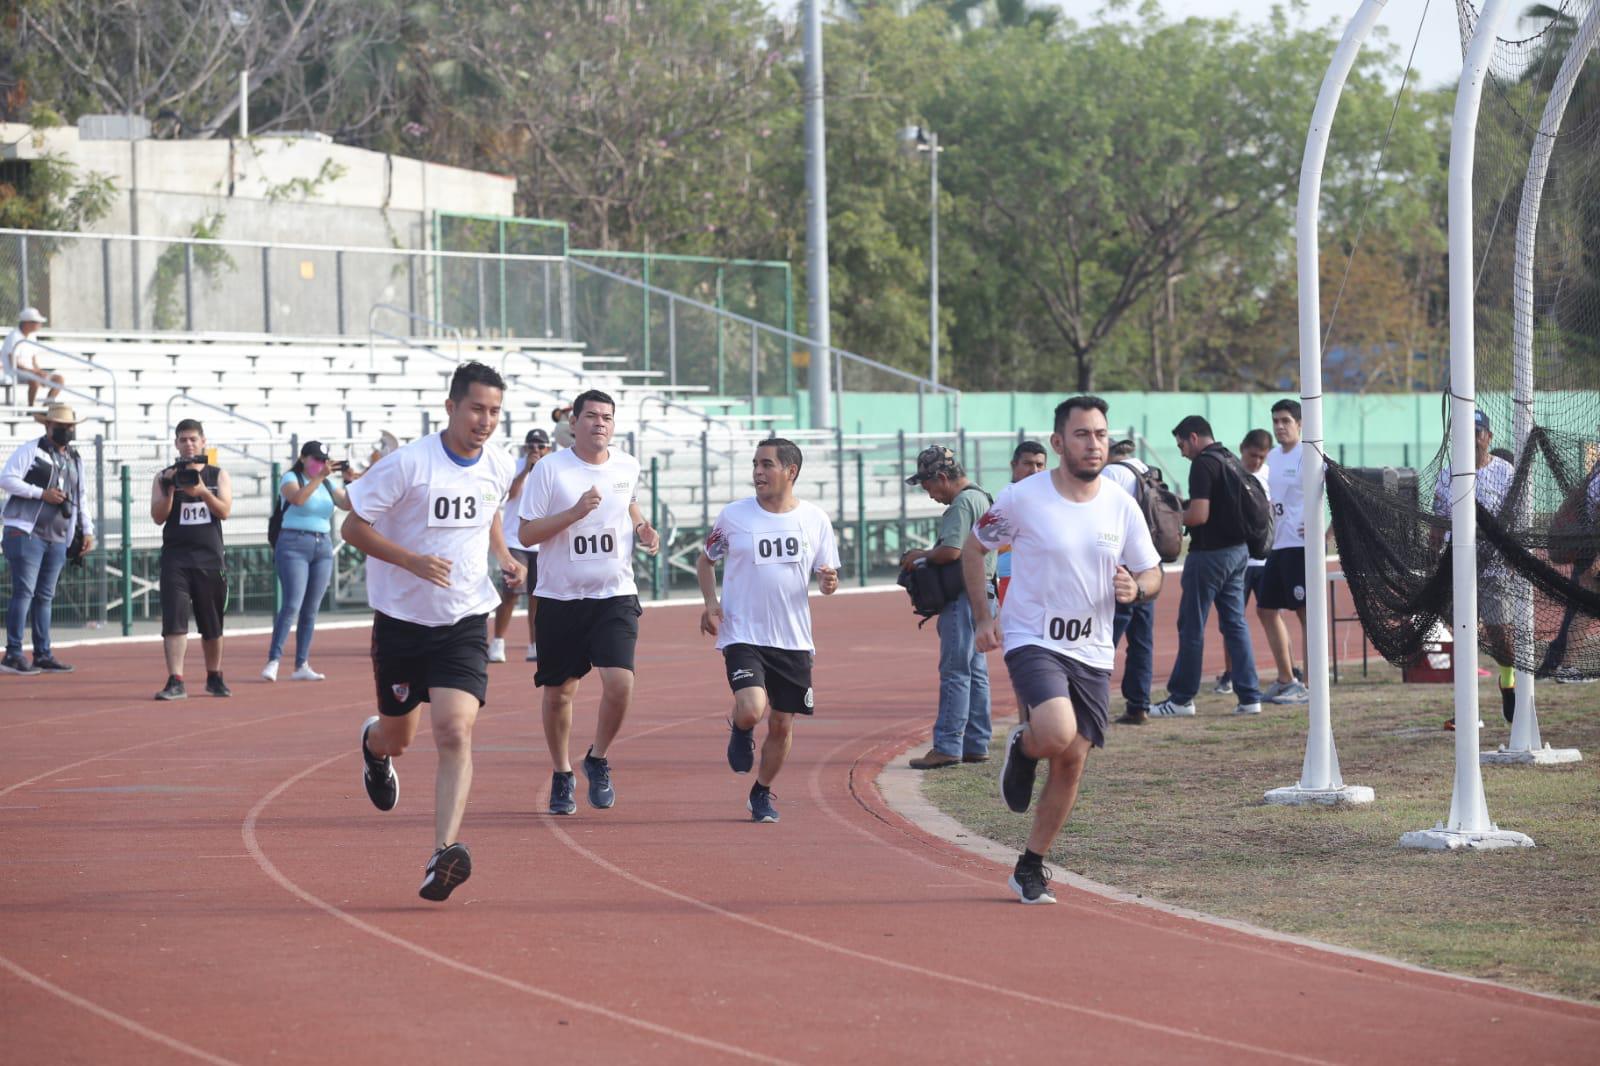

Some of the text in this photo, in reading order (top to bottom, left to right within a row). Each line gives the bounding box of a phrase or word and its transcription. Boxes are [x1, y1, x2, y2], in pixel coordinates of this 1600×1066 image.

[183, 507, 207, 520] 014
[434, 496, 477, 520] 013
[573, 534, 614, 555] 010
[758, 537, 799, 558] 019
[1049, 616, 1092, 642] 004
